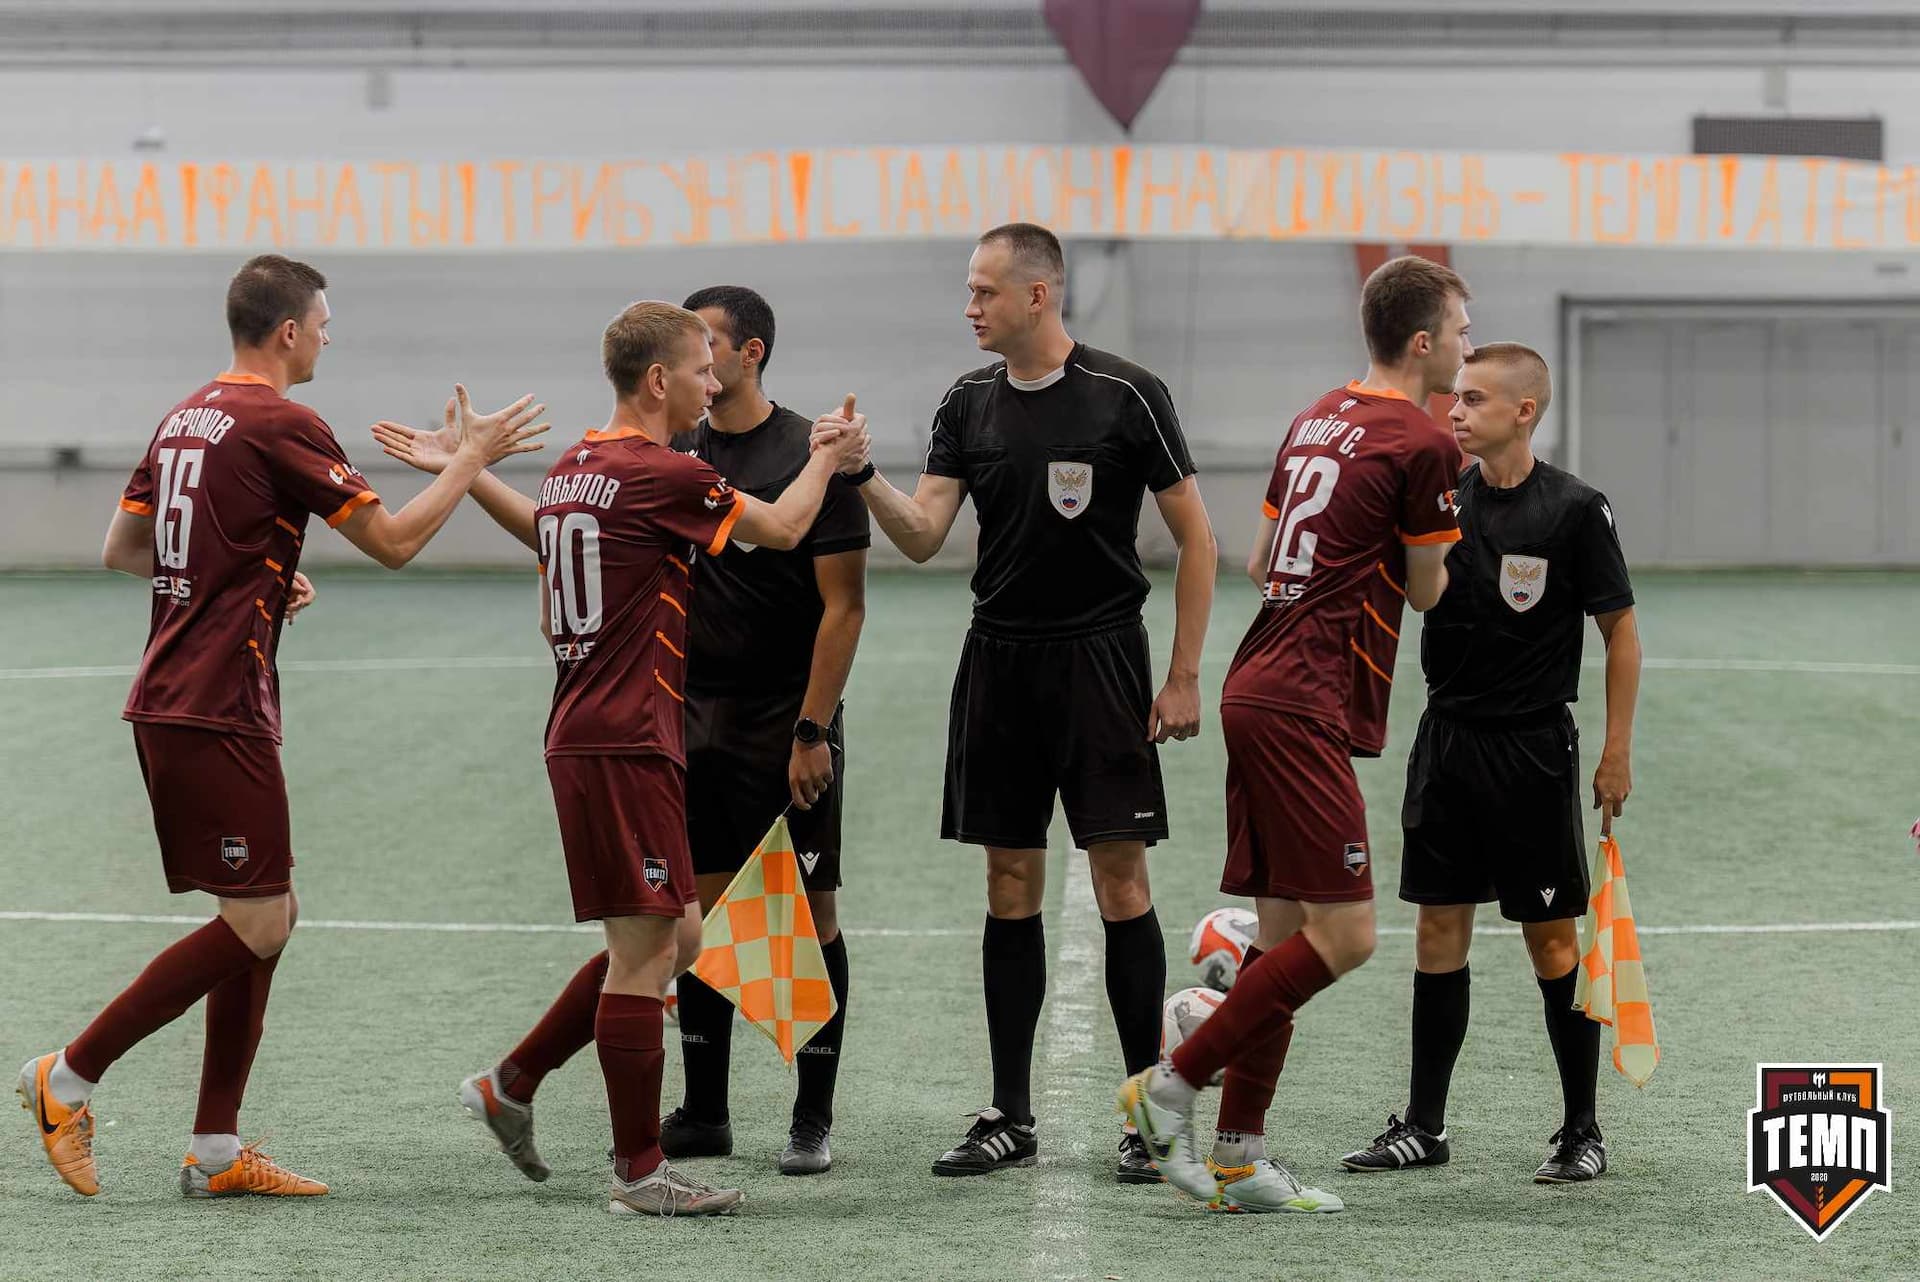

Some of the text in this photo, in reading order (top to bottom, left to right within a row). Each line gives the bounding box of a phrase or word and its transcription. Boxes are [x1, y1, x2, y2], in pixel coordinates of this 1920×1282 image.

[535, 473, 620, 510] АВЬЯЛОВ
[1267, 456, 1340, 577] 12
[538, 512, 603, 635] 20
